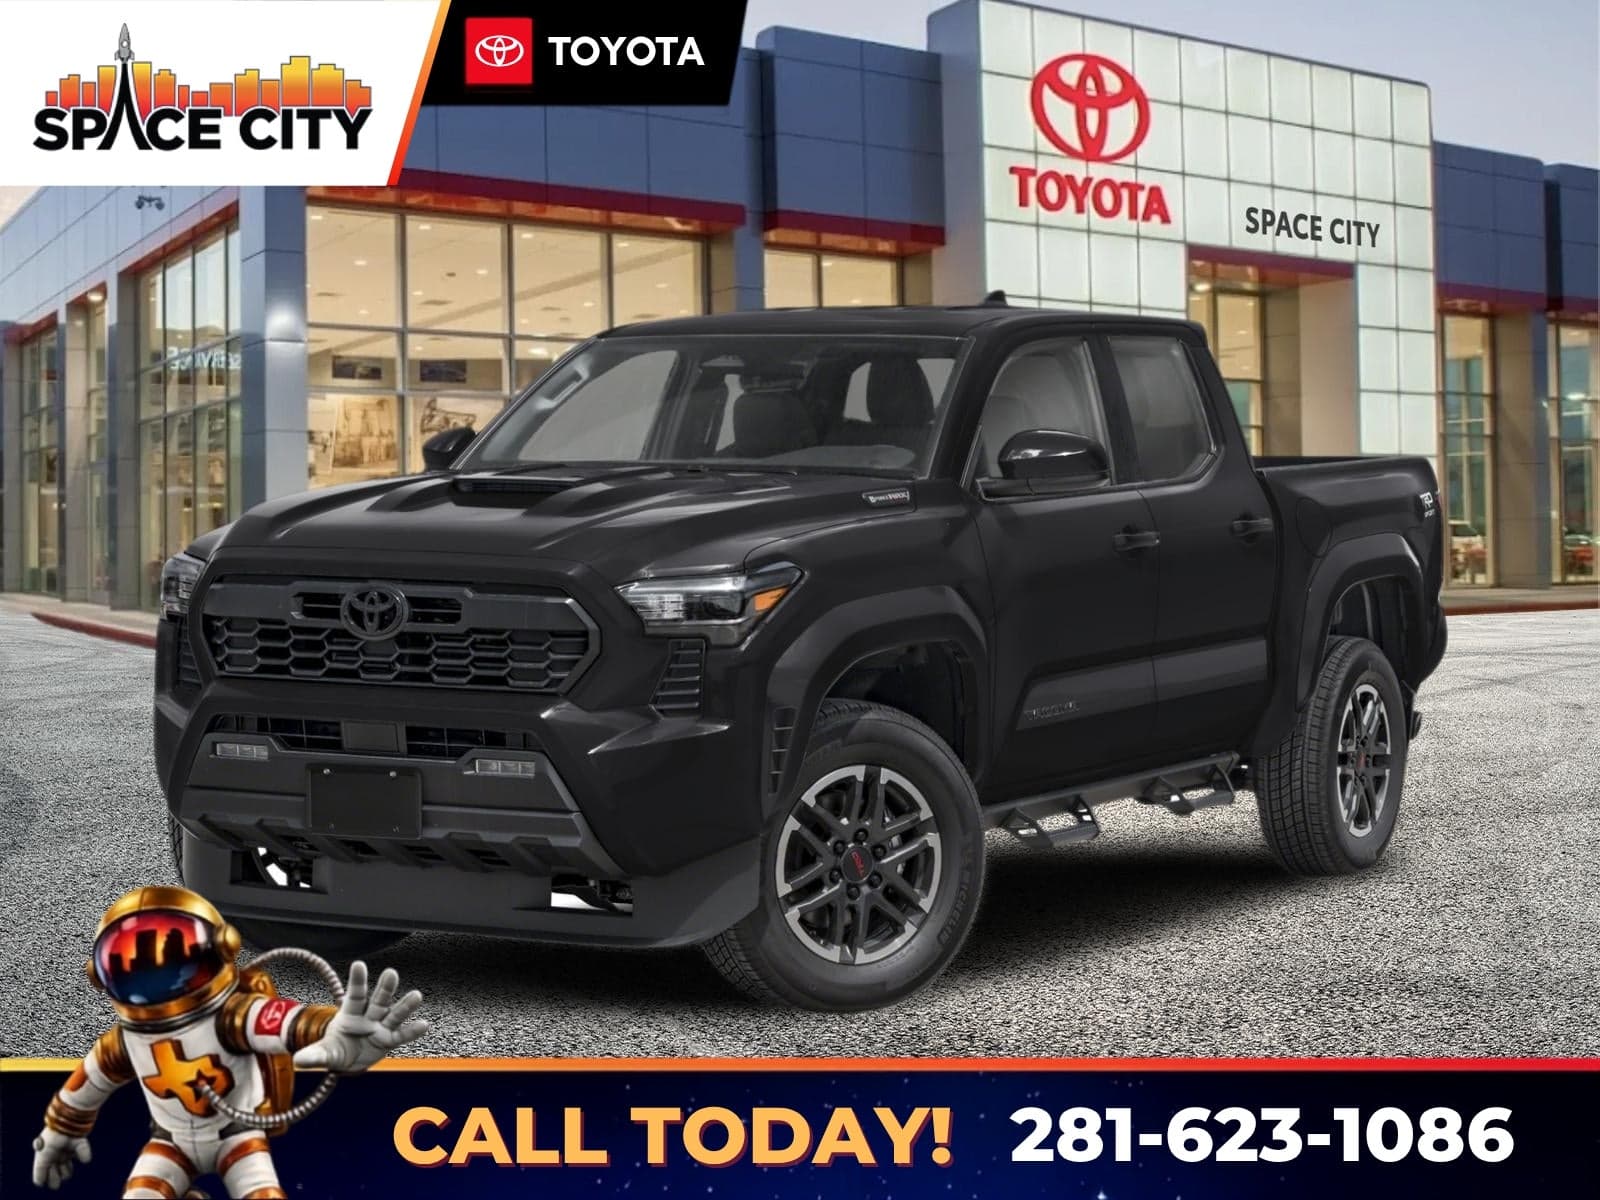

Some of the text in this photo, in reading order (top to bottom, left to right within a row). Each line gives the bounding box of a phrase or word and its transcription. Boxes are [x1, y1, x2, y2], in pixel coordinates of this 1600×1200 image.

[1009, 166, 1171, 224] TOYOTA
[1245, 207, 1381, 248] SPACE CITY
